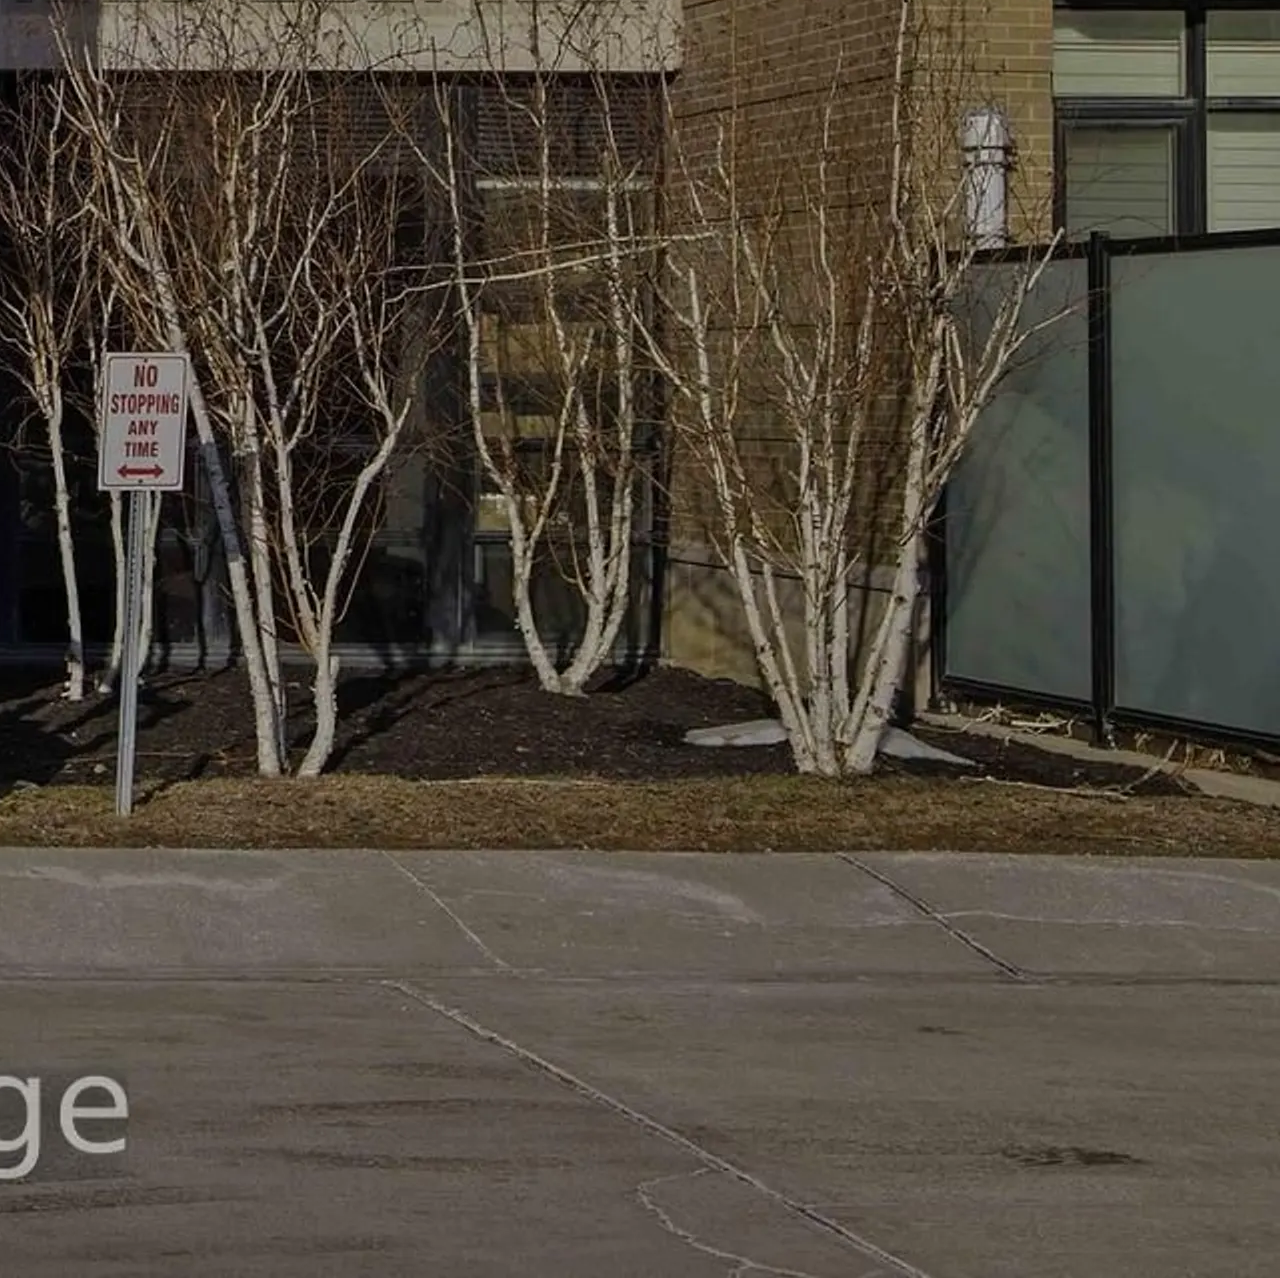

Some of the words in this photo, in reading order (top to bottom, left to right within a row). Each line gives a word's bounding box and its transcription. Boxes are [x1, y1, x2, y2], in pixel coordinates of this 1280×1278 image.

[133, 365, 158, 388] NO
[110, 393, 180, 415] STOPPING
[127, 420, 159, 436] ANY
[124, 441, 159, 458] TIME
